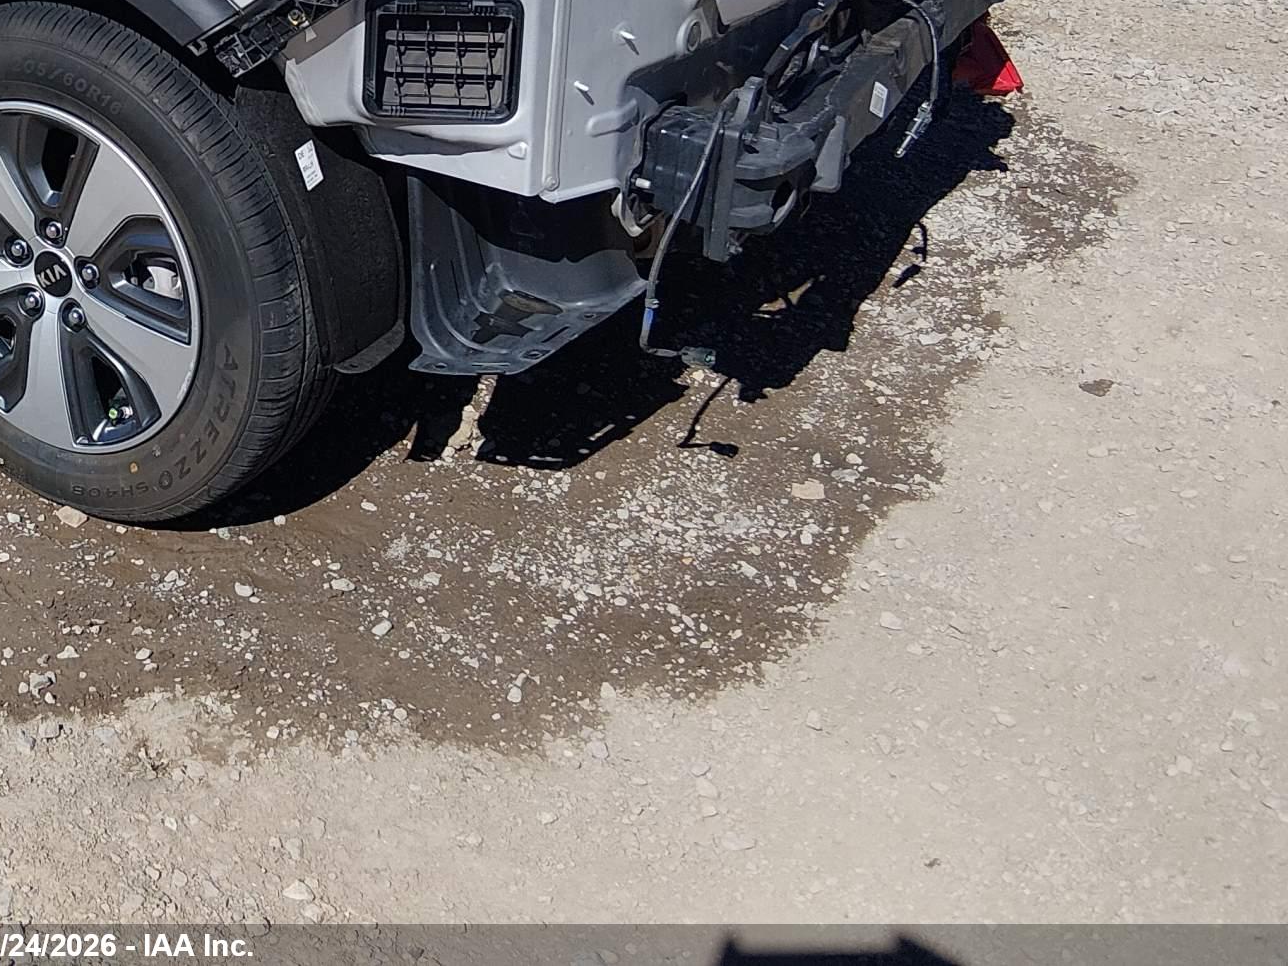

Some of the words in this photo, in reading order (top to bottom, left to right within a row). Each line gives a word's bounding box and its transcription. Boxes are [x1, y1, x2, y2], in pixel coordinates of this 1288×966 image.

[37, 264, 67, 288] KIA
[158, 341, 239, 491] ATREZZO
[71, 480, 149, 498] SH408
